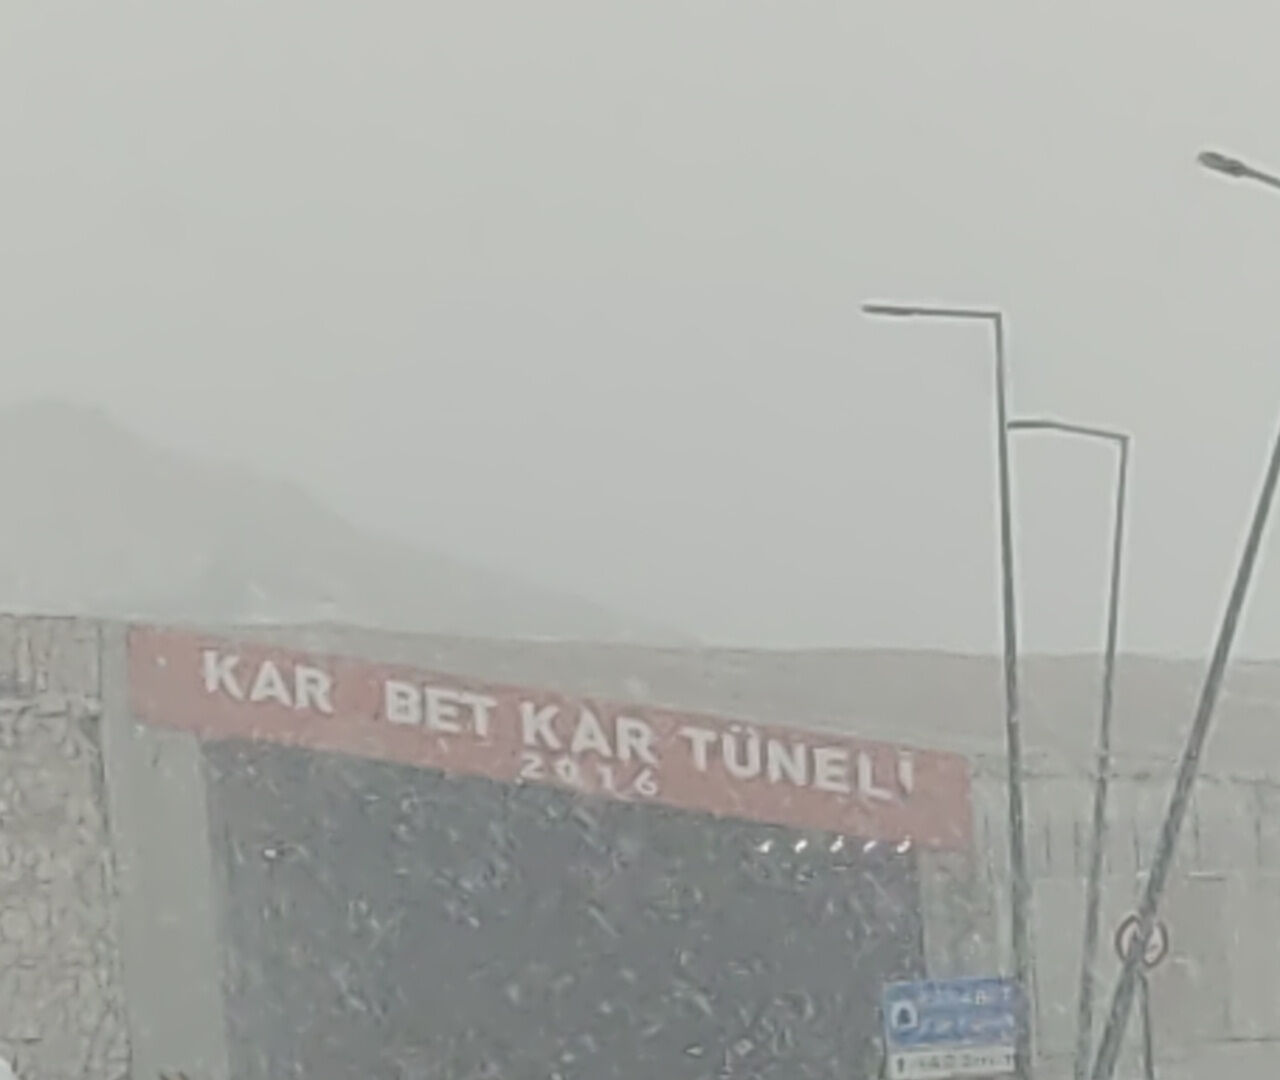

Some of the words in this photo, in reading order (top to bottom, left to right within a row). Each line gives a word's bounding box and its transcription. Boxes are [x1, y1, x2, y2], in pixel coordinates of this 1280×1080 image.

[203, 649, 334, 714] KAR
[384, 679, 498, 738] BET
[520, 700, 658, 767] KAR
[519, 752, 658, 796] 2016
